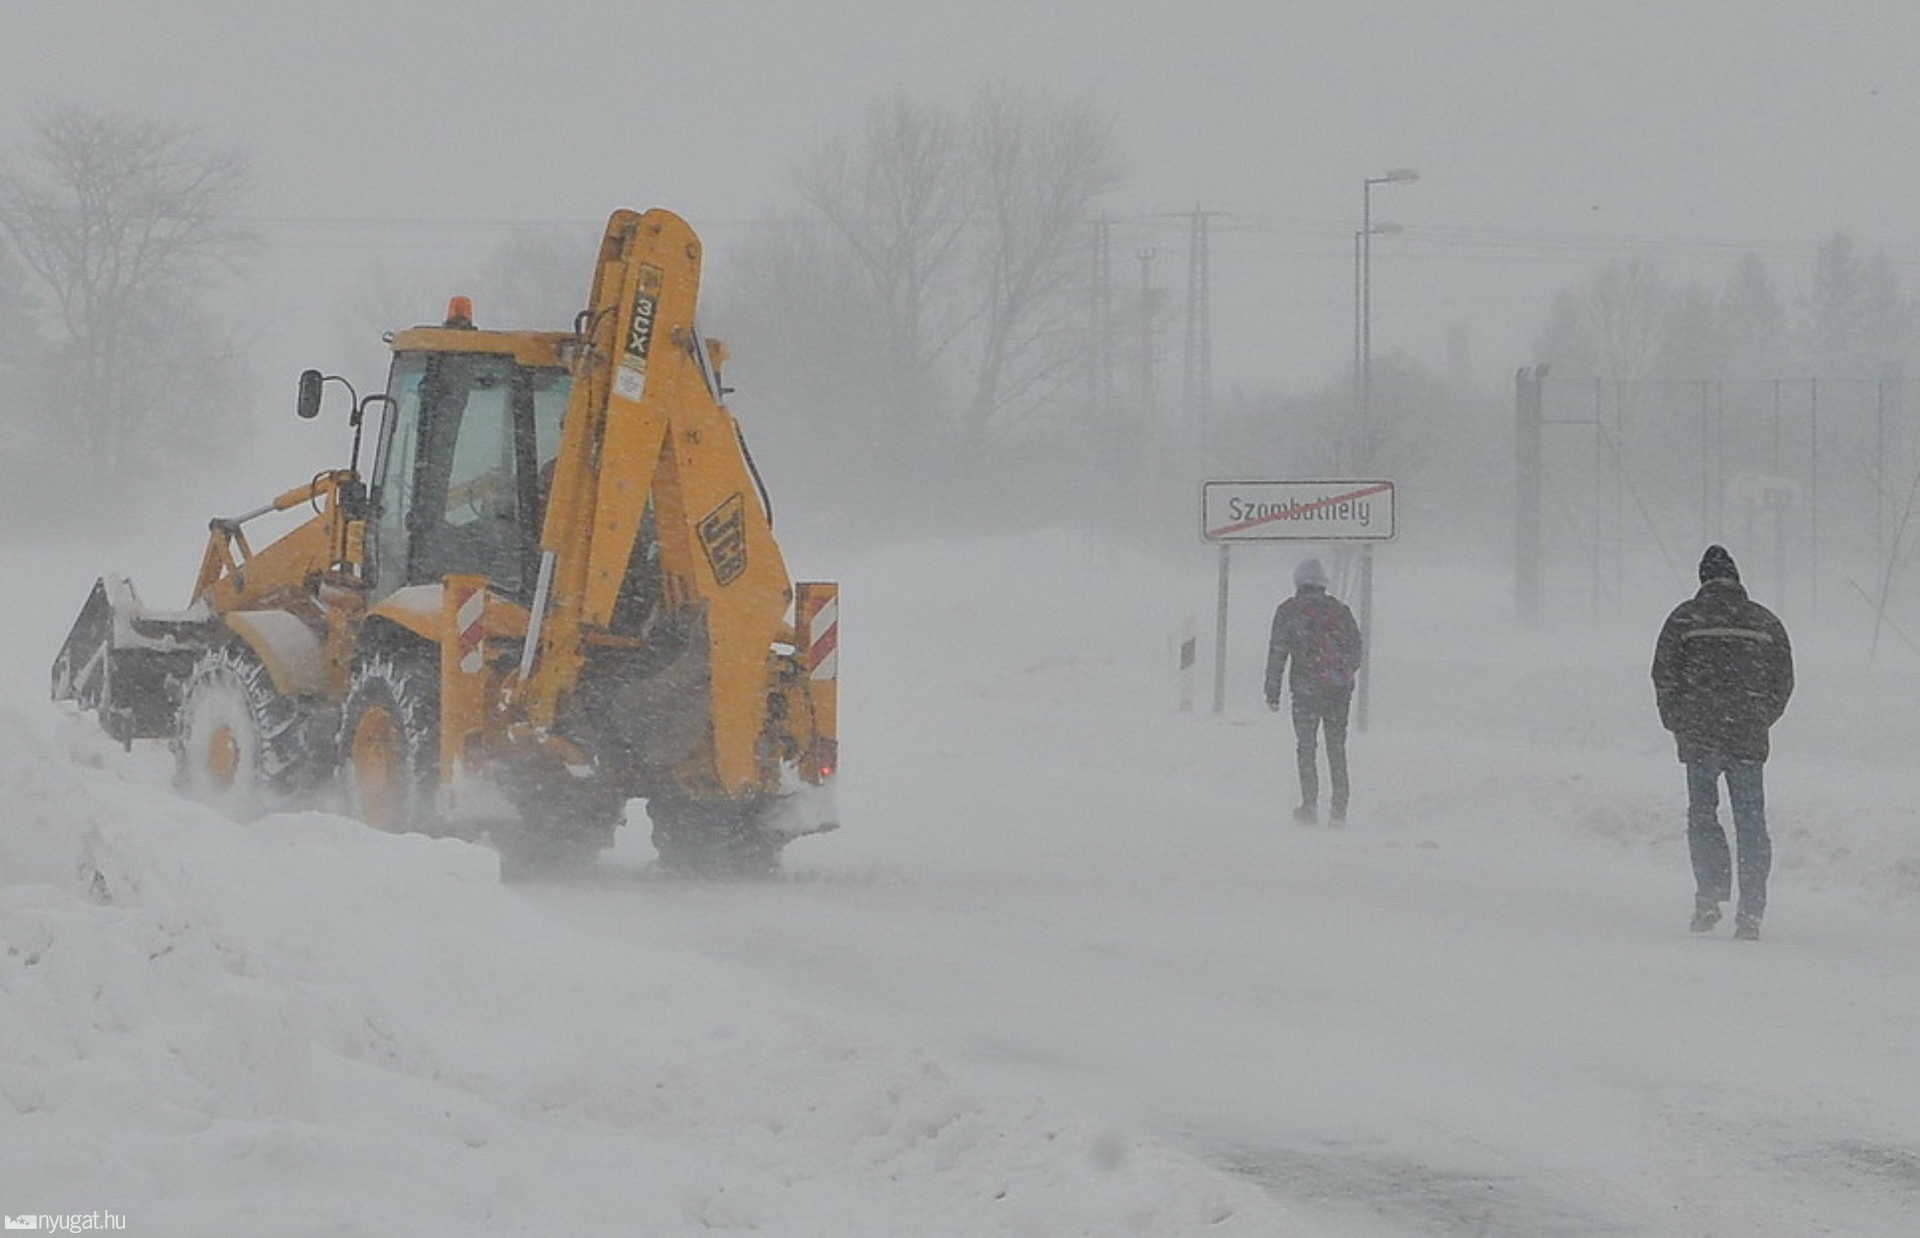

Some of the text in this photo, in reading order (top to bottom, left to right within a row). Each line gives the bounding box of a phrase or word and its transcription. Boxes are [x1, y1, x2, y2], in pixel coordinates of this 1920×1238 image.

[630, 298, 652, 353] 3CX
[1229, 496, 1371, 527] Szombathely
[702, 507, 743, 581] JCB
